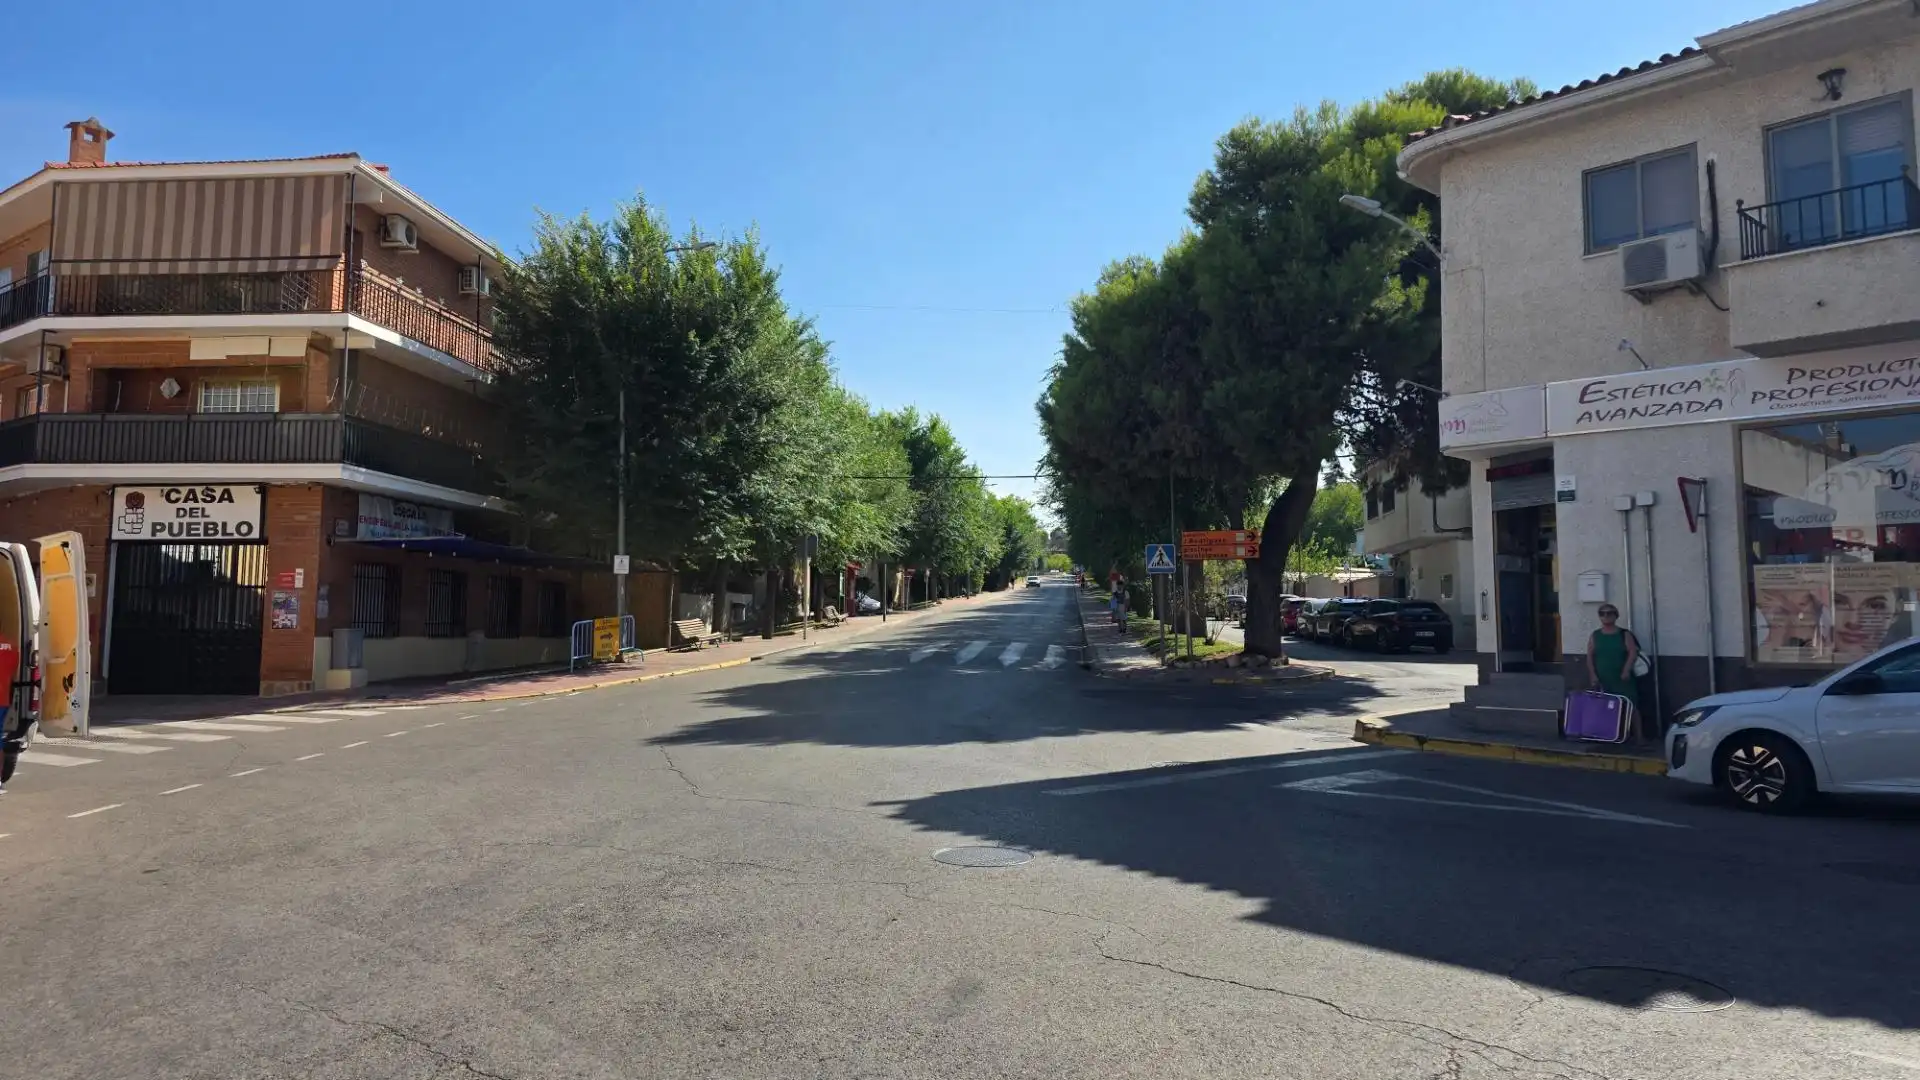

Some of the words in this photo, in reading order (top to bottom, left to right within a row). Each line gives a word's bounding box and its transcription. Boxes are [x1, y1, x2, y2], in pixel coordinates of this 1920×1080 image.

[1787, 357, 1920, 384] PRODUCT
[1576, 398, 1723, 424] AVANZADA
[164, 487, 235, 504] CASA
[175, 507, 210, 518] DEL
[151, 521, 254, 537] PUEBLO
